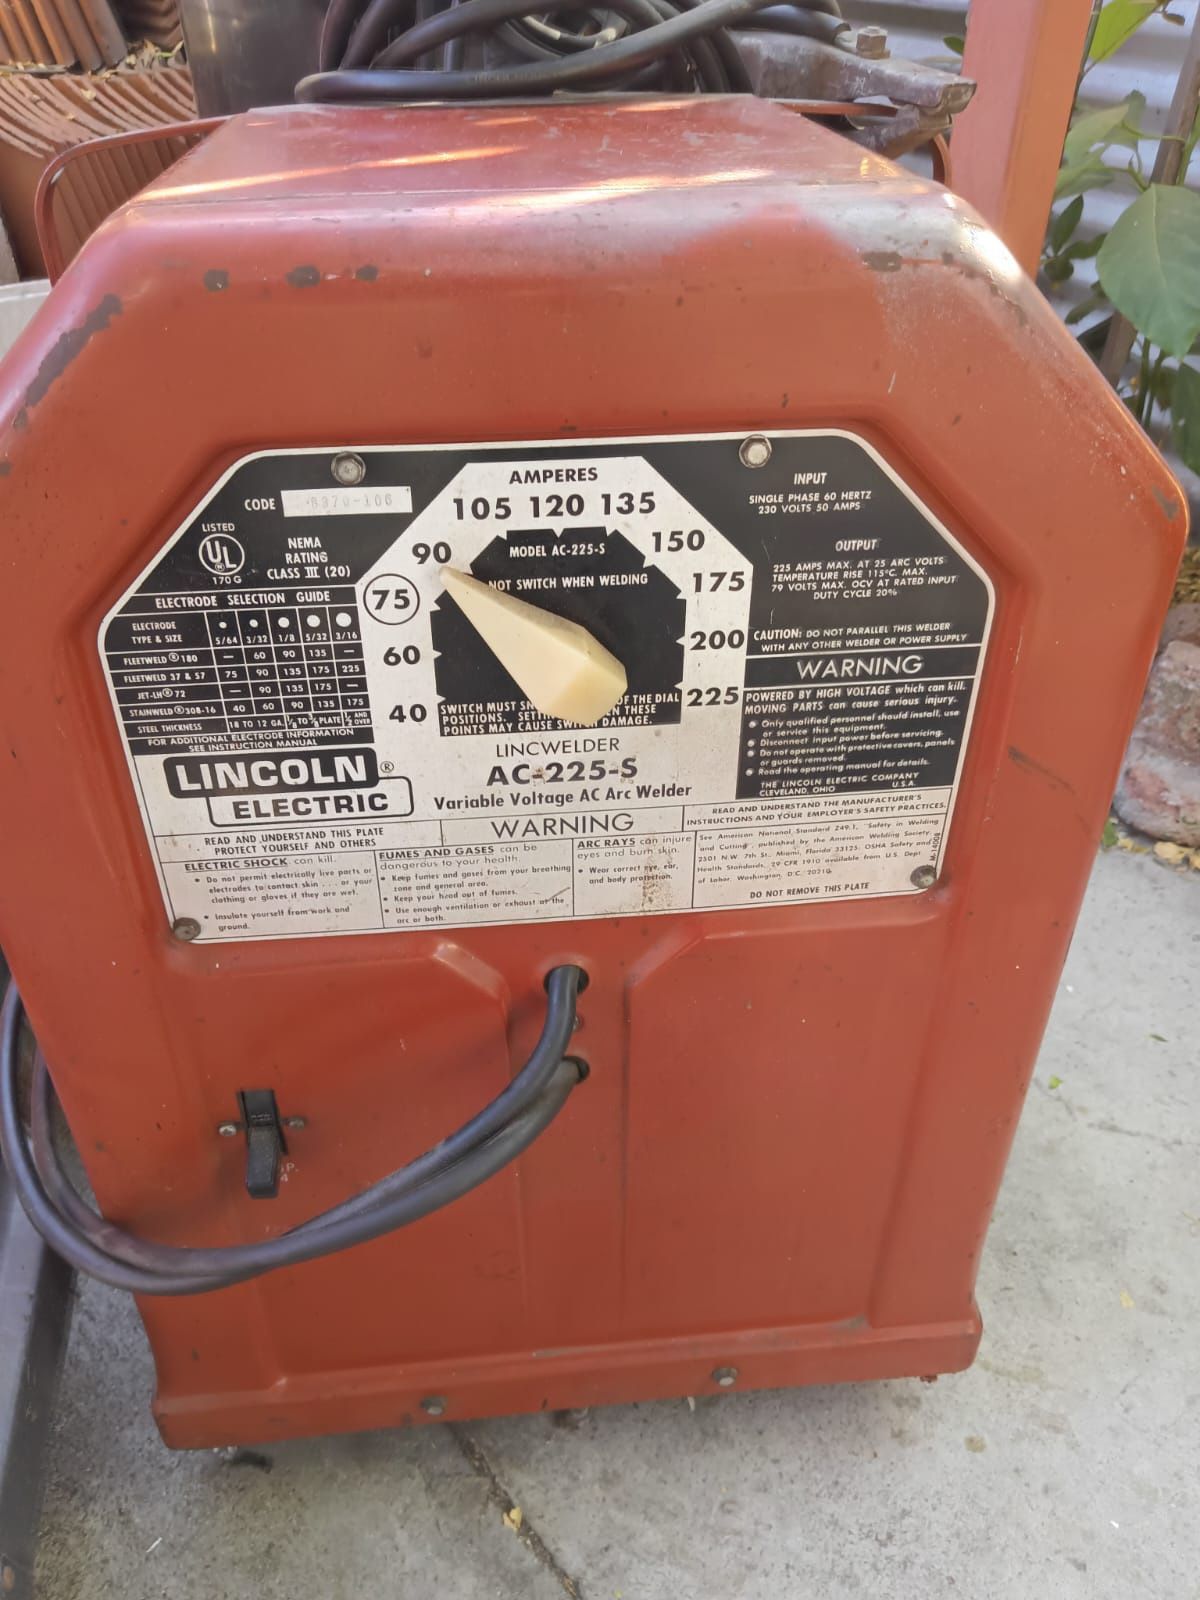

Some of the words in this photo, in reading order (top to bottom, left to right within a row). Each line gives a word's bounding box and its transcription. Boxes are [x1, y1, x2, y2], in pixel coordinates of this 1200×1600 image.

[509, 467, 598, 484] AMPERES
[794, 472, 828, 484] INPUT
[245, 498, 276, 511] CODE
[453, 497, 512, 520] 105
[530, 494, 584, 518] 120
[602, 492, 656, 515] 135
[749, 494, 784, 504] SINGLE
[788, 492, 819, 502] PHASE
[824, 492, 836, 501] 60
[841, 491, 871, 500] HERTZ
[758, 505, 777, 514] 230
[782, 504, 811, 513] VOLTS
[816, 503, 828, 512] 50
[834, 502, 860, 511] AMPS
[202, 523, 235, 532] LISTED
[288, 537, 322, 548] NEMA
[652, 530, 705, 552] 150
[836, 539, 877, 551] OUTPUT
[286, 552, 328, 563] RATING
[412, 542, 451, 564] 90
[510, 545, 546, 558] MODEL
[552, 544, 605, 556] AC-225-S
[267, 568, 300, 580] CLASS
[325, 566, 350, 578] (20)
[773, 571, 840, 582] TEMPERATURE
[843, 570, 863, 579] RISE
[489, 580, 511, 591] NOT
[516, 578, 556, 590] SWITCH
[562, 576, 594, 588] WHEN
[600, 573, 648, 585] WELDING
[693, 571, 744, 593] 175
[771, 584, 783, 592] 79
[788, 582, 817, 591] VOLTS
[852, 579, 873, 588] OCV
[877, 578, 890, 586] AT
[894, 577, 923, 586] RATED
[928, 575, 957, 584] INPUT
[156, 596, 218, 609] ELECTRODE
[228, 593, 285, 605] SELECTION
[296, 591, 330, 602] GUIDE
[372, 589, 410, 610] 75
[814, 591, 838, 600] DUTY
[843, 590, 871, 598] CYCLE
[876, 588, 897, 597] 20%
[132, 622, 176, 631] ELECTRODE
[806, 630, 820, 638] DO
[823, 629, 844, 637] NOT
[847, 625, 888, 636] PARALLEL
[893, 624, 912, 633] THIS
[916, 623, 950, 632] WELDER
[132, 636, 152, 644] TYPE
[165, 634, 183, 643] SIZE
[215, 637, 238, 645] 5/64
[246, 635, 268, 643] 3/32
[278, 634, 294, 642] 1/8
[305, 633, 327, 641] 5/32
[336, 632, 357, 640] 3/16
[690, 630, 744, 650] 200
[384, 645, 420, 666] 60
[123, 675, 166, 683] FLEETWELD
[170, 673, 180, 681] 37
[256, 669, 268, 677] 90
[284, 668, 301, 676] 135
[312, 666, 329, 674] 175
[342, 665, 359, 673] 225
[797, 655, 924, 679] WARNING
[687, 687, 739, 707] 225
[746, 692, 794, 702] POWERED
[799, 690, 812, 699] BY
[816, 688, 841, 698] HIGH
[847, 685, 890, 696] VOLTAGE
[896, 684, 924, 694] which
[928, 684, 944, 692] can
[441, 704, 483, 714] SWITCH
[487, 701, 516, 712] MUST
[617, 695, 629, 704] OF
[633, 694, 651, 704] THE
[656, 693, 679, 702] DIAL
[625, 705, 656, 714] THESE
[745, 704, 786, 715] MOVING
[793, 702, 823, 712] PARTS
[829, 702, 846, 710] can
[852, 700, 879, 708] cause
[884, 697, 919, 707] serious
[389, 704, 427, 722] 40
[762, 719, 783, 729] Only
[786, 716, 828, 727] qualified
[830, 714, 875, 725] personnel
[878, 712, 907, 721] should
[148, 737, 166, 746] FOR
[169, 734, 227, 745] ADDITIONAL
[232, 731, 283, 741] ELECTRODE
[286, 728, 354, 739] INFORMATION
[189, 744, 205, 752] SEE
[208, 741, 274, 751] INSTRUCTION
[277, 739, 318, 747] MANUAL
[496, 738, 620, 757] LINCWELDER
[176, 755, 367, 791] LINCOLN
[486, 757, 638, 786] AC-225-S
[782, 778, 821, 788] LINCOLN
[826, 776, 868, 784] ELECTRIC
[871, 772, 920, 782] COMPANY
[434, 793, 504, 810] Variable
[510, 790, 573, 807] Voltage
[580, 788, 600, 801] AC
[606, 786, 630, 800] Arc
[636, 784, 692, 799] Welder
[232, 794, 389, 819] ELECTRIC
[491, 813, 634, 838] WARNING
[205, 837, 230, 846] READ
[236, 835, 256, 844] AND
[262, 830, 326, 842] UNDERSTAND
[331, 830, 351, 838] THIS
[356, 828, 384, 836] PLATE
[578, 839, 601, 848] ARC
[604, 838, 635, 847] RAYS
[662, 836, 691, 844] injure
[214, 846, 256, 855] PROTECT
[262, 843, 309, 852] YOURSELF
[314, 841, 335, 849] AND
[340, 838, 376, 848] OTHERS
[379, 851, 420, 860] FUMES
[424, 848, 450, 856] AND
[455, 846, 494, 854] GASES
[524, 843, 537, 851] be
[185, 860, 240, 871] ELECTRIC
[244, 858, 288, 867] SHOCK
[750, 891, 762, 899] DO
[766, 889, 783, 897] NOT
[787, 886, 819, 896] REMOVE
[844, 882, 870, 891] PLATE
